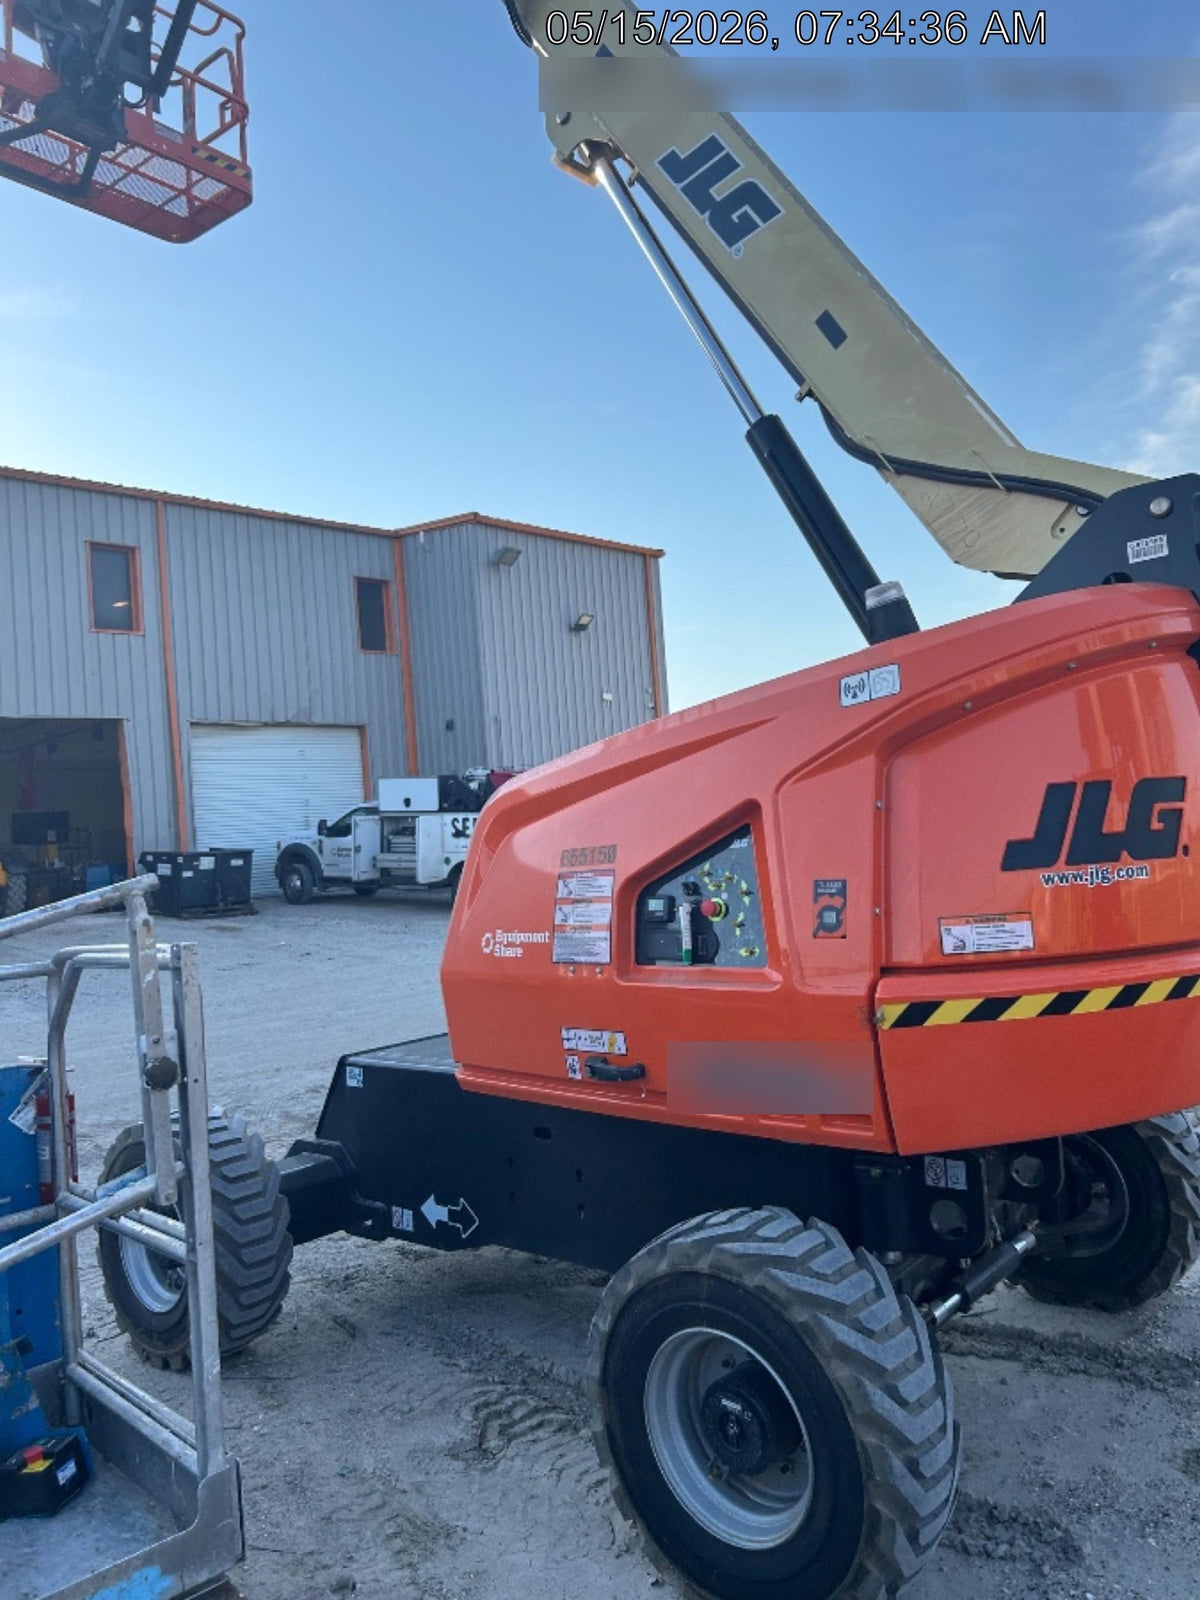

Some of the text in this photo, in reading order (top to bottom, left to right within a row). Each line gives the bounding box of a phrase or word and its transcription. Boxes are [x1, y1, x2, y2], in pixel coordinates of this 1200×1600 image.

[655, 132, 786, 252] JLG
[451, 817, 478, 838] SE
[1001, 776, 1187, 871] JLG
[1042, 864, 1150, 887] www.jlg.com
[495, 929, 550, 945] Equipment
[493, 943, 523, 957] Share
